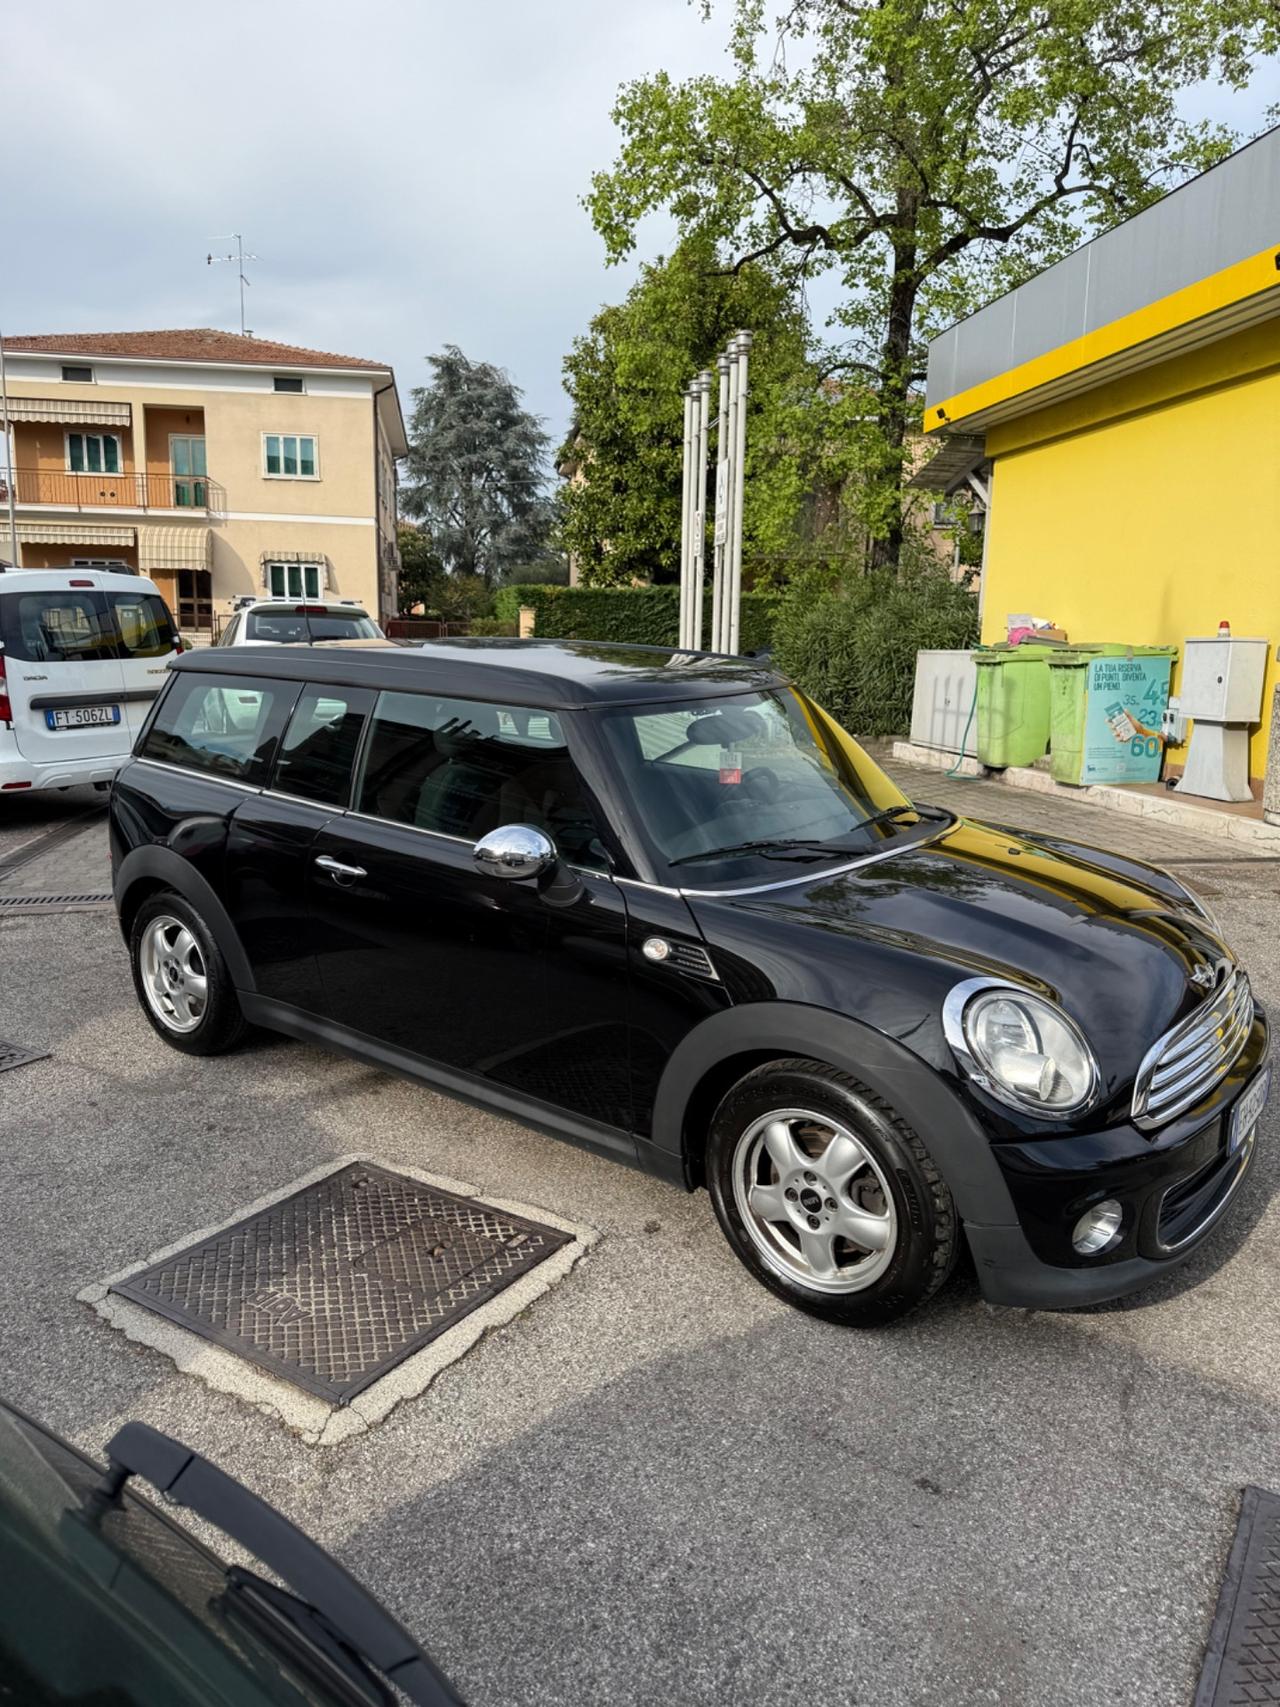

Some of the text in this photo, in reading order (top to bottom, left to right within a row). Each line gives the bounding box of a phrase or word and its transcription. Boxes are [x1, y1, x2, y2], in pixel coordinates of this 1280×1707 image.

[1094, 663, 1142, 672] LA TUA RISERVA
[1094, 672, 1101, 682] DI
[1122, 672, 1147, 681] DIVENTA
[1093, 682, 1102, 691] UN
[1122, 694, 1137, 705] 35
[55, 708, 112, 725] FT 506ZL
[1138, 708, 1158, 727] 23
[1130, 734, 1159, 758] 60
